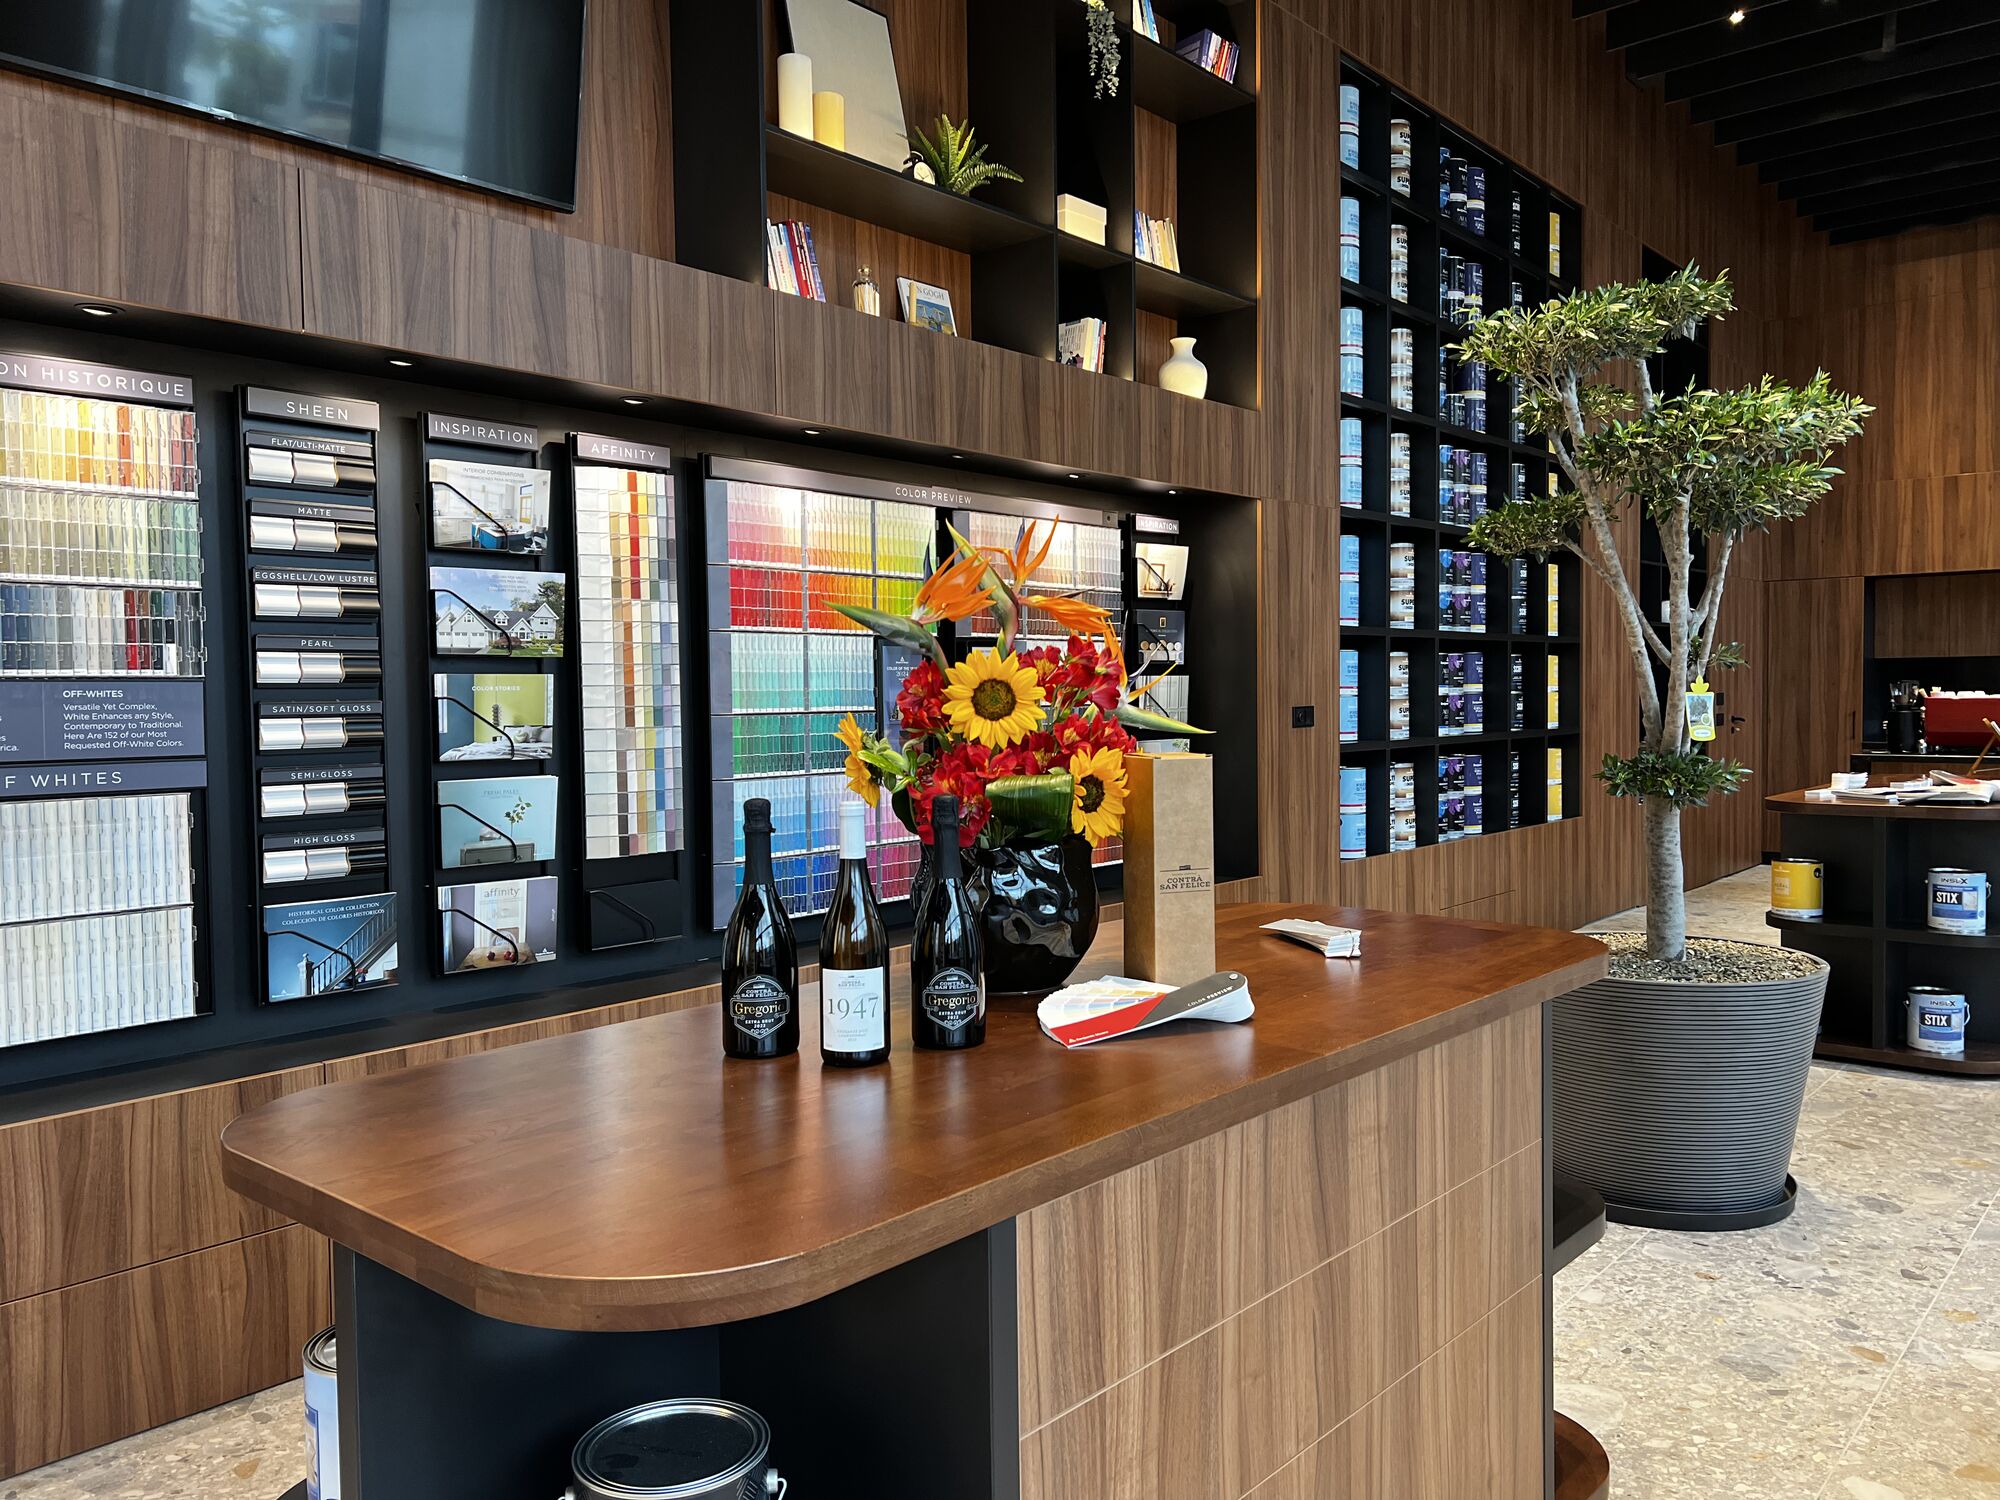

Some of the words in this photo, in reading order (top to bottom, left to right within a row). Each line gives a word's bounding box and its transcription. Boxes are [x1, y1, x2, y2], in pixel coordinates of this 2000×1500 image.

[42, 367, 184, 397] HISTORIQUE
[286, 401, 348, 421] SHEEN
[434, 420, 533, 445] INSPIRATION
[271, 438, 346, 453] FLAT/ULTI-MATTE
[591, 443, 656, 461] AFFINITY
[895, 487, 927, 499] COLOR
[931, 491, 971, 504] PREVIEW
[298, 507, 332, 516] MATTE
[1138, 519, 1177, 530] INSPIRATION
[255, 572, 335, 582] EGGSHELL/LOW
[339, 575, 375, 583] LUSTRE
[301, 640, 334, 648] PEARL
[63, 690, 123, 698] OFF-WHITES
[63, 703, 100, 711] Versatile
[118, 703, 157, 712] Complex,
[272, 705, 335, 713] SATIN/SOFT
[92, 712, 132, 720] Enhances
[151, 712, 174, 721] Style,
[63, 722, 125, 732] Contemporary
[139, 721, 183, 729] Traditional.
[64, 732, 84, 740] Here
[87, 732, 102, 740] Are
[64, 741, 110, 751] Requested
[113, 740, 153, 748] Off-White
[156, 739, 183, 747] Colors.
[31, 771, 122, 788] WHITES
[291, 770, 353, 780] SEMI-GLOSS
[293, 837, 320, 845] HIGH
[323, 834, 356, 842] GLOSS
[1180, 881, 1211, 889] FELICE
[484, 887, 520, 898] affinity
[1936, 891, 1958, 904] STIX
[288, 908, 324, 917] HISTORICAL
[325, 906, 344, 914] COLOR
[345, 902, 380, 912] COLLECTION
[327, 913, 353, 921] COLORES
[929, 993, 976, 1009] Gregorio
[828, 996, 879, 1020] 1947
[1924, 1014, 1947, 1026] STIX
